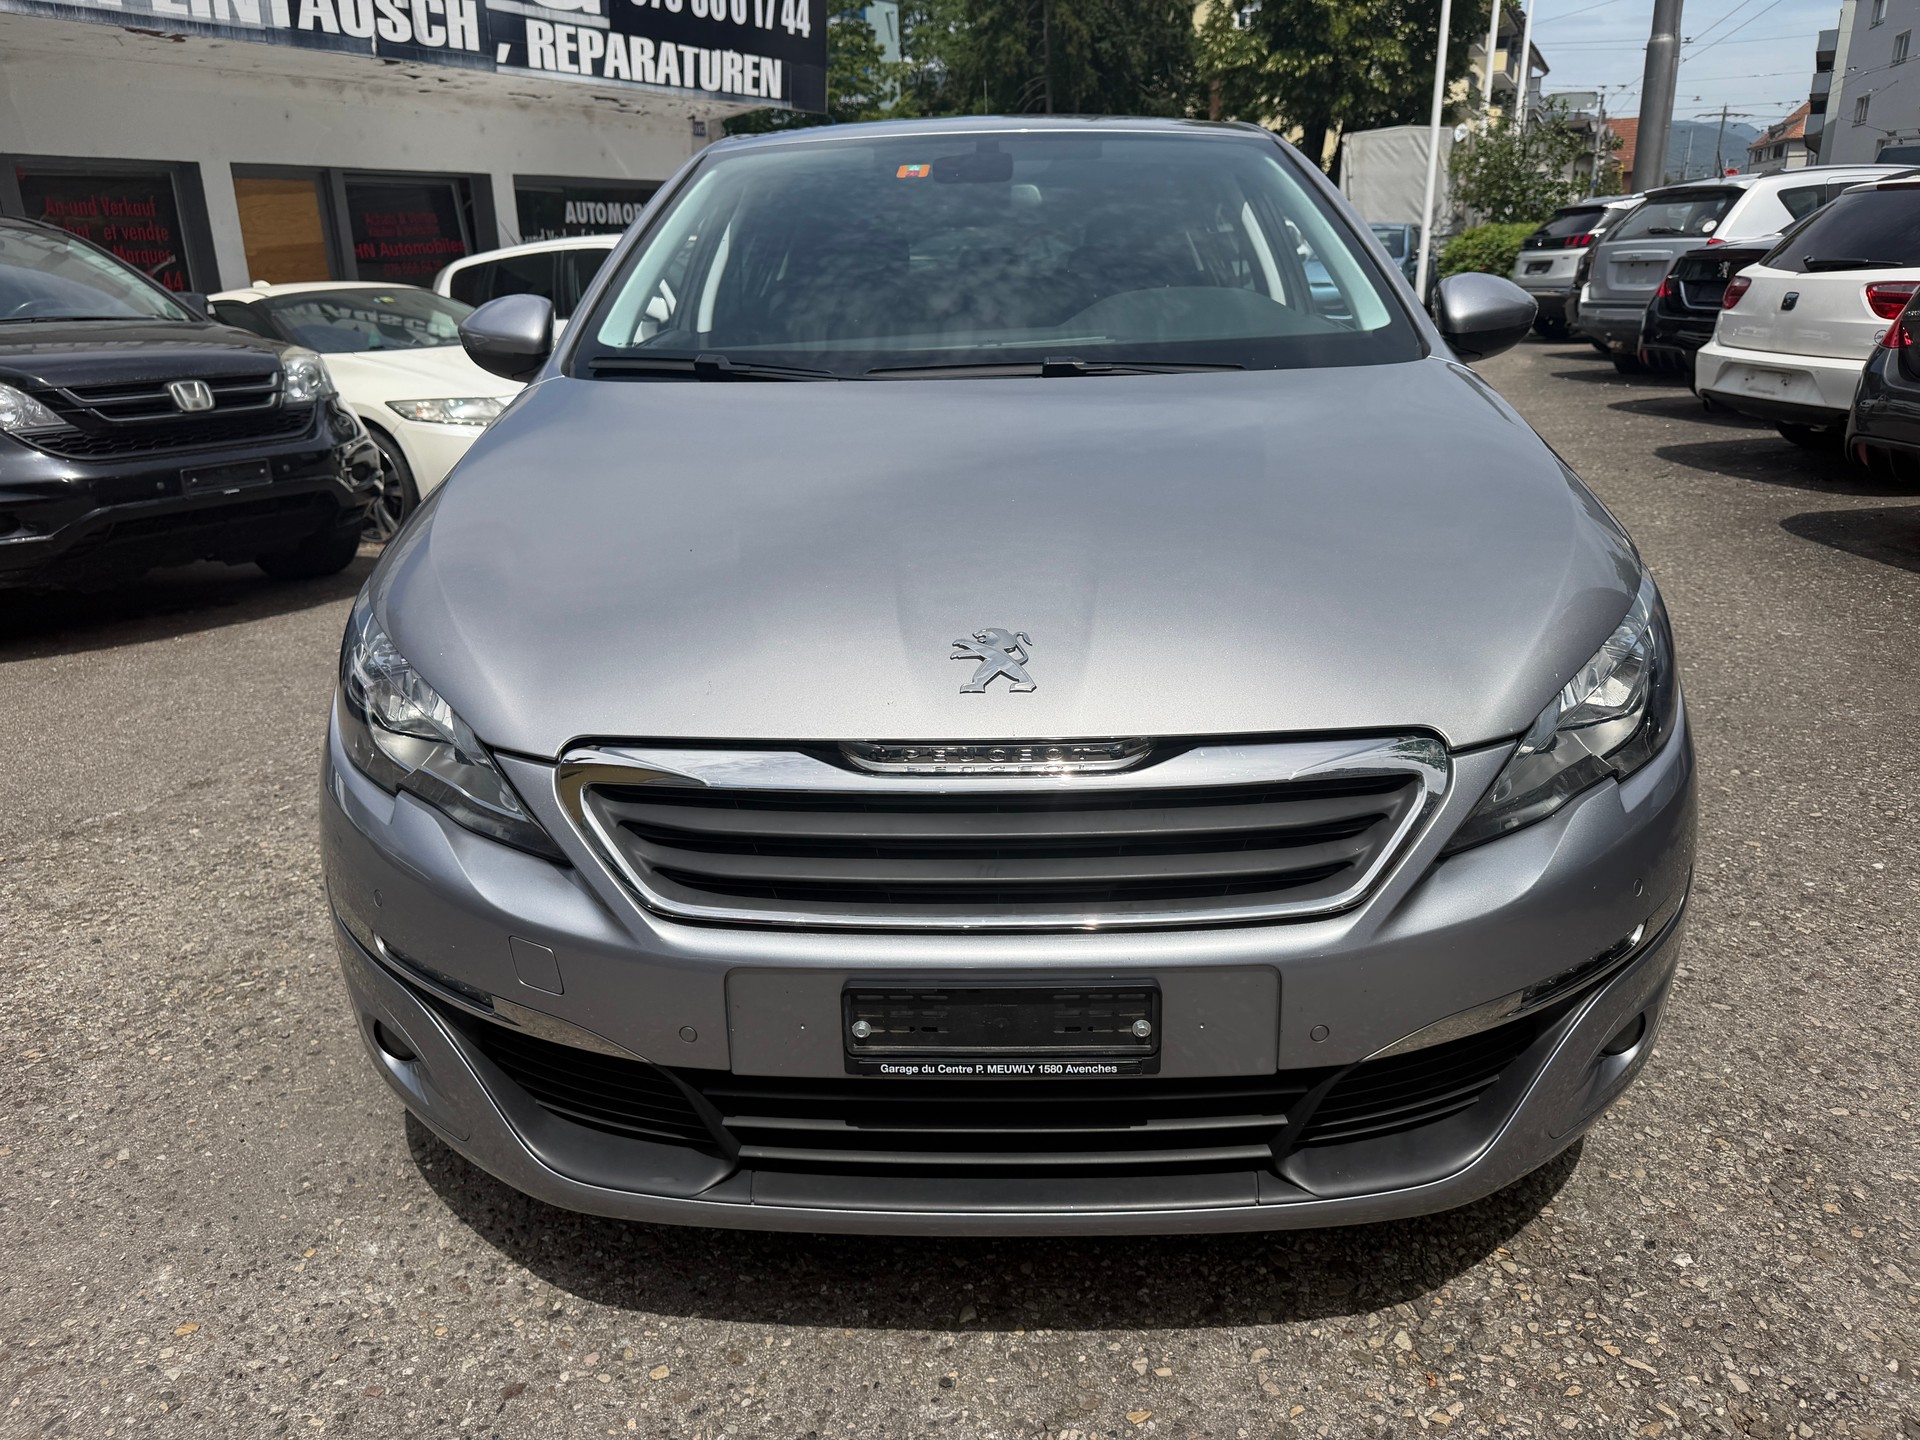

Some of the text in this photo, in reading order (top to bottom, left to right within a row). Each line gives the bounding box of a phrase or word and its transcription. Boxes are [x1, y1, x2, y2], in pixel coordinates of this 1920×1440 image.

[151, 0, 480, 51] AUSCH
[525, 19, 782, 99] REPARATUREN
[100, 196, 156, 217] Verkauf
[121, 220, 169, 241] vendre
[380, 237, 466, 257] Automobiles
[902, 747, 1090, 762] PEUGEOT
[880, 1064, 1118, 1075] Garage du Centre P. MEUWLY 1580 Avenches
